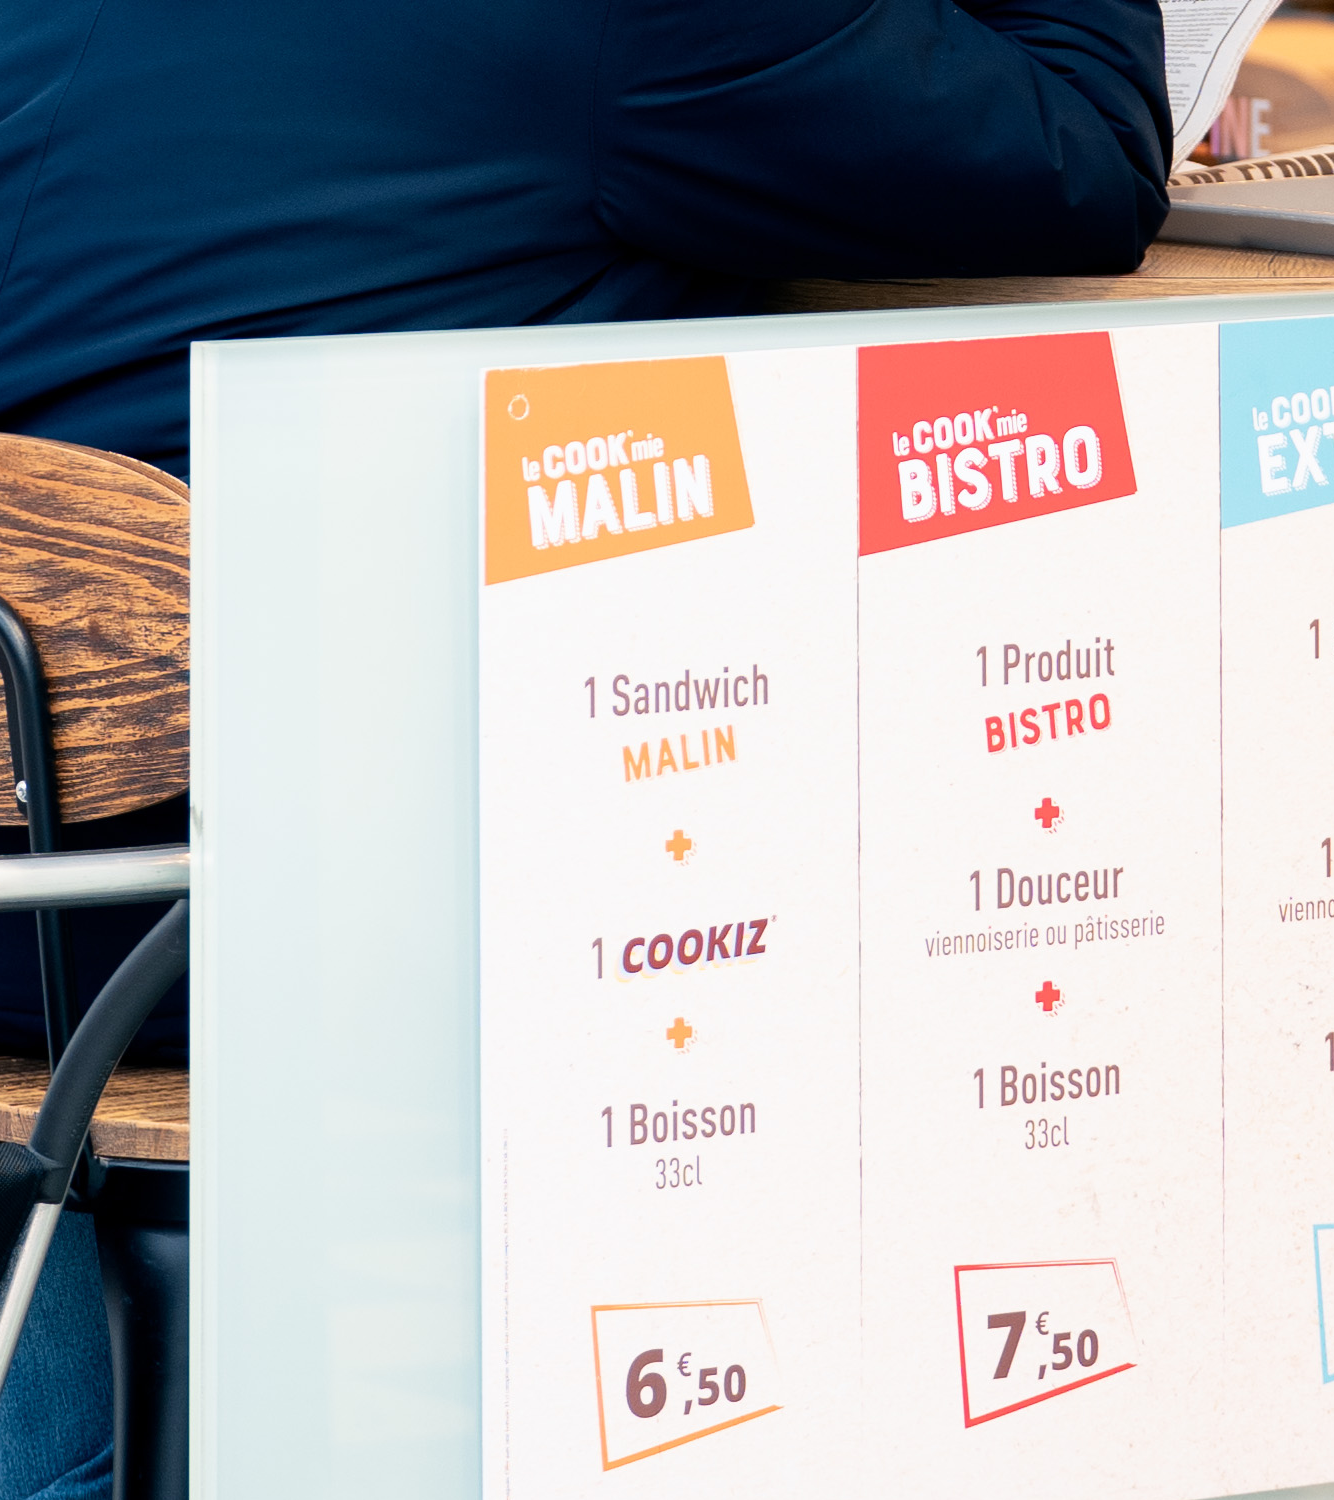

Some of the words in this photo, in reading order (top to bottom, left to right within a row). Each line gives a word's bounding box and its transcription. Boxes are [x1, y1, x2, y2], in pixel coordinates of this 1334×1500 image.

[1252, 405, 1269, 432] le
[892, 431, 911, 457] le
[522, 456, 542, 482] le
[898, 425, 1103, 524] BISTRO
[527, 454, 714, 550] MALIN
[975, 645, 989, 688] 1
[1002, 636, 1116, 687] Produit
[1308, 618, 1321, 661] 1
[583, 676, 597, 720] 1
[611, 663, 770, 718] Sandwich
[983, 692, 1113, 755] BISTRO
[621, 724, 737, 784] MALIN
[1319, 837, 1334, 879] 1
[968, 869, 982, 913] 1
[995, 866, 1125, 911] Douceur
[590, 937, 604, 981] 1
[924, 927, 1040, 959] viennoiserie
[1044, 925, 1068, 947] ou
[1073, 915, 1166, 951] pâtisserie
[972, 1067, 985, 1110] 1
[999, 1061, 1121, 1108] Boisson
[600, 1105, 614, 1149] 1
[628, 1099, 757, 1147] Boisson
[1023, 1115, 1071, 1151] 33cl
[654, 1155, 704, 1191] 33cl
